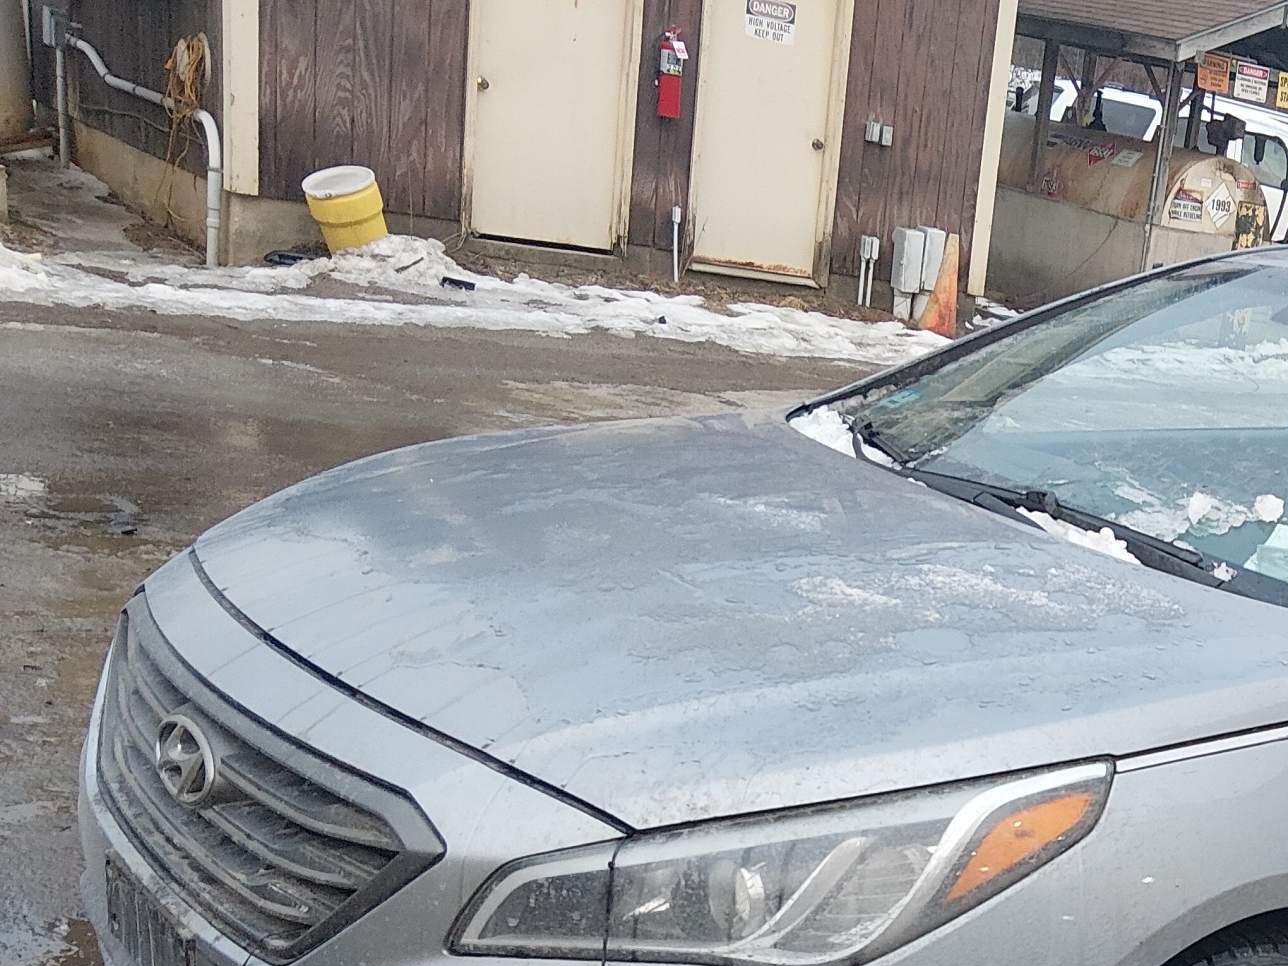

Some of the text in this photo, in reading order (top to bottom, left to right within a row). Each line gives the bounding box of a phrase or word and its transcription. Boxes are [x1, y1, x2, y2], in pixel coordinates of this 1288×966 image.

[753, 1, 790, 18] DANGER
[749, 17, 791, 33] HIGH VOLTAGE
[754, 28, 784, 42] KEEP OUT
[1211, 199, 1231, 212] 1993
